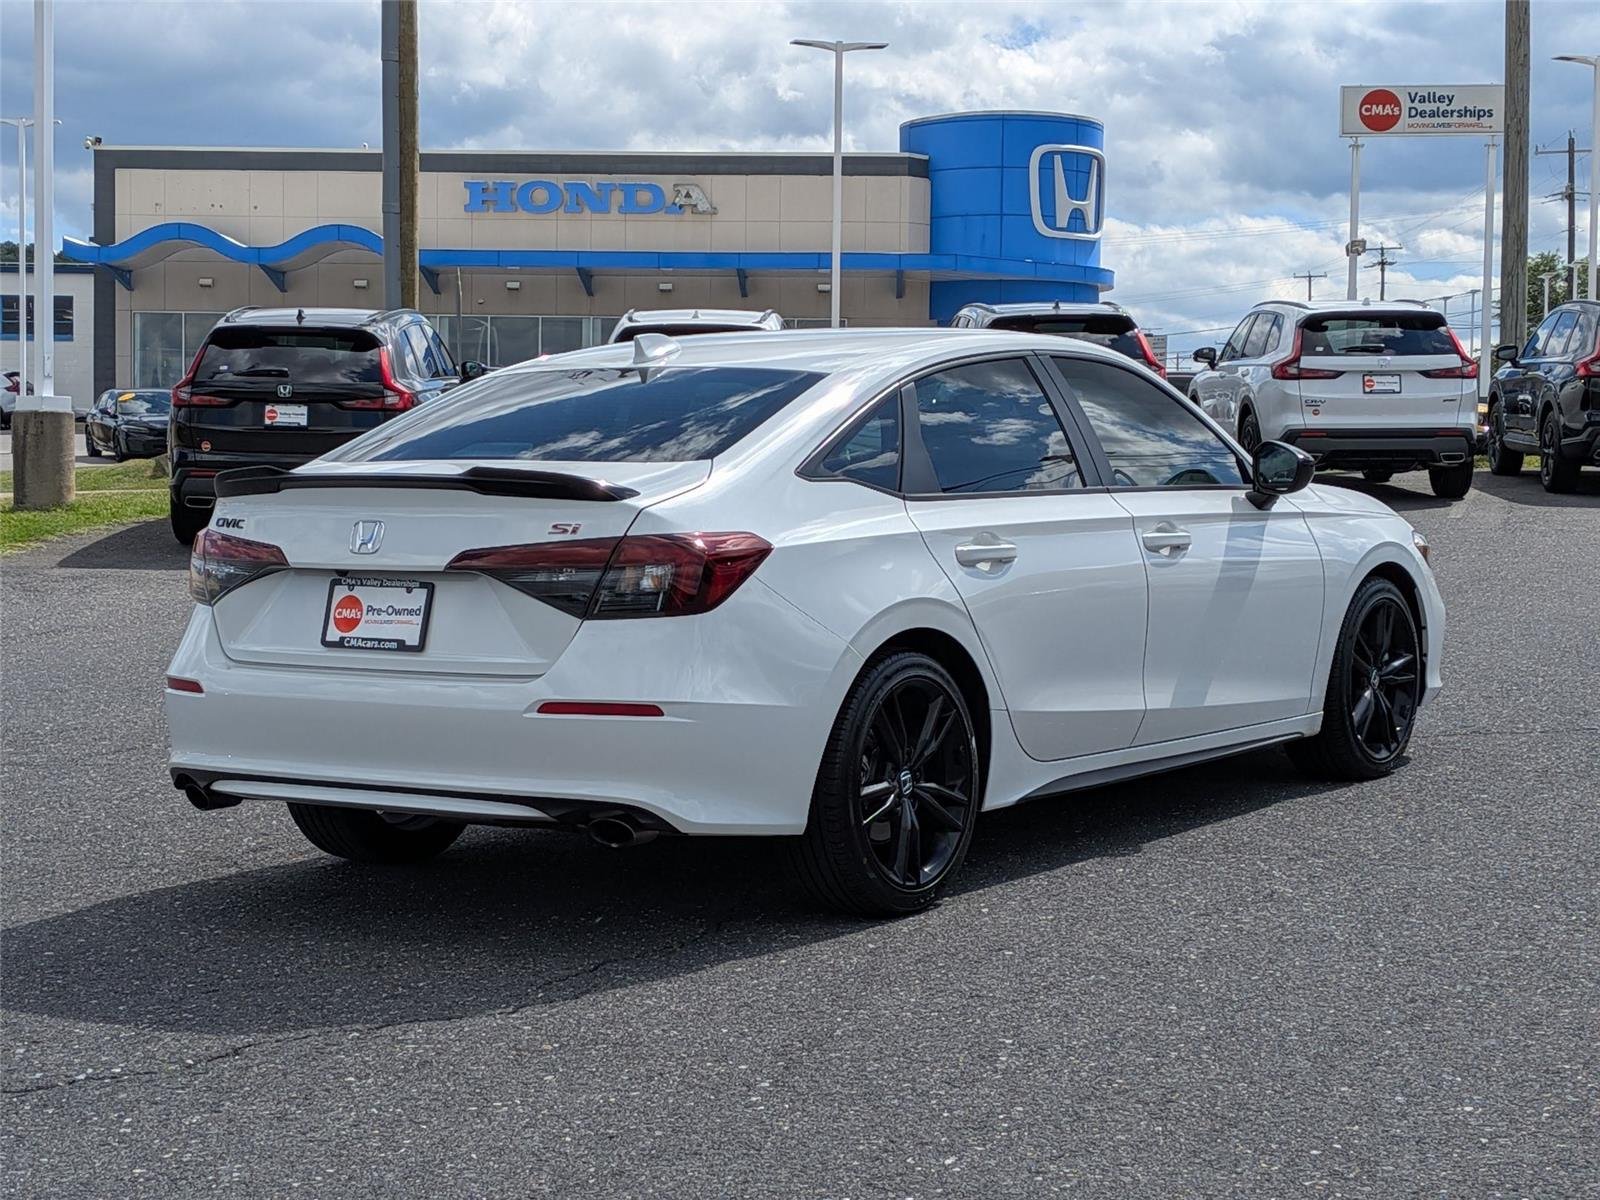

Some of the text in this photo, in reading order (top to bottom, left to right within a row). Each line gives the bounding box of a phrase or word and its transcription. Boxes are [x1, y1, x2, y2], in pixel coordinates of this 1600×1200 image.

[1408, 91, 1455, 106] Valley
[1361, 103, 1400, 116] CMA's
[1407, 105, 1494, 121] Dealerships
[463, 180, 719, 215] HONDA
[547, 523, 582, 535] Si
[341, 577, 420, 588] CMA's Valley Dealerships
[335, 608, 362, 619] CMA's
[366, 605, 422, 616] Pre-Owned
[343, 637, 398, 649] CMAcars.com
